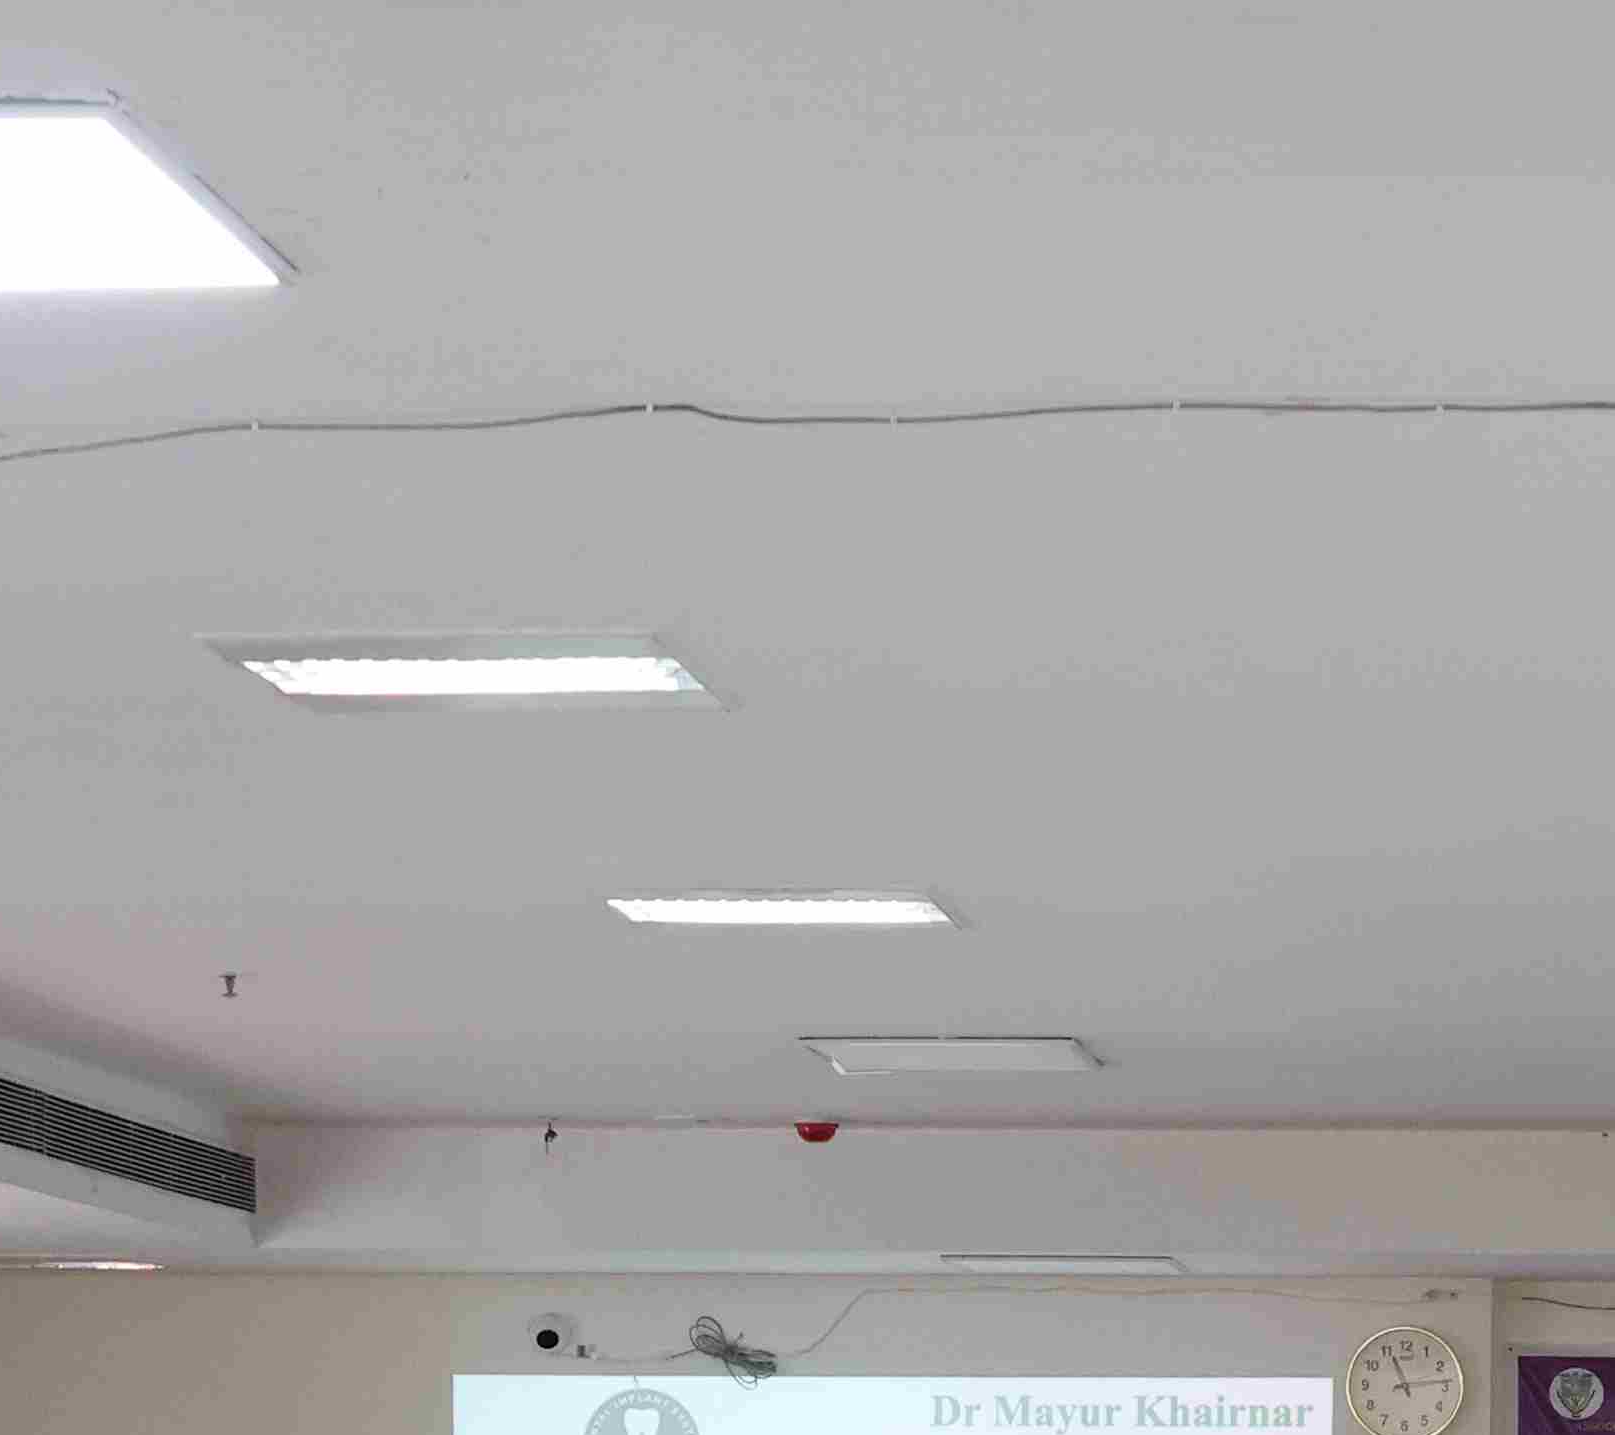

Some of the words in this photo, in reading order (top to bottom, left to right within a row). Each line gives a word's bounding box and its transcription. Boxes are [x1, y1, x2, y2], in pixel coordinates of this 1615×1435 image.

[1382, 1345, 1392, 1357] 11
[1400, 1340, 1412, 1351] 12
[1424, 1346, 1429, 1358] 1
[1365, 1360, 1379, 1371] 10
[1435, 1360, 1444, 1372] 2
[1362, 1379, 1369, 1391] 9
[1442, 1380, 1449, 1392] 3
[930, 1395, 981, 1427] Dr
[993, 1395, 1122, 1435] Mayur
[1133, 1394, 1314, 1428] Khairnar
[1380, 1414, 1388, 1426] 7
[1421, 1415, 1428, 1426] 5
[1400, 1421, 1408, 1432] 6
